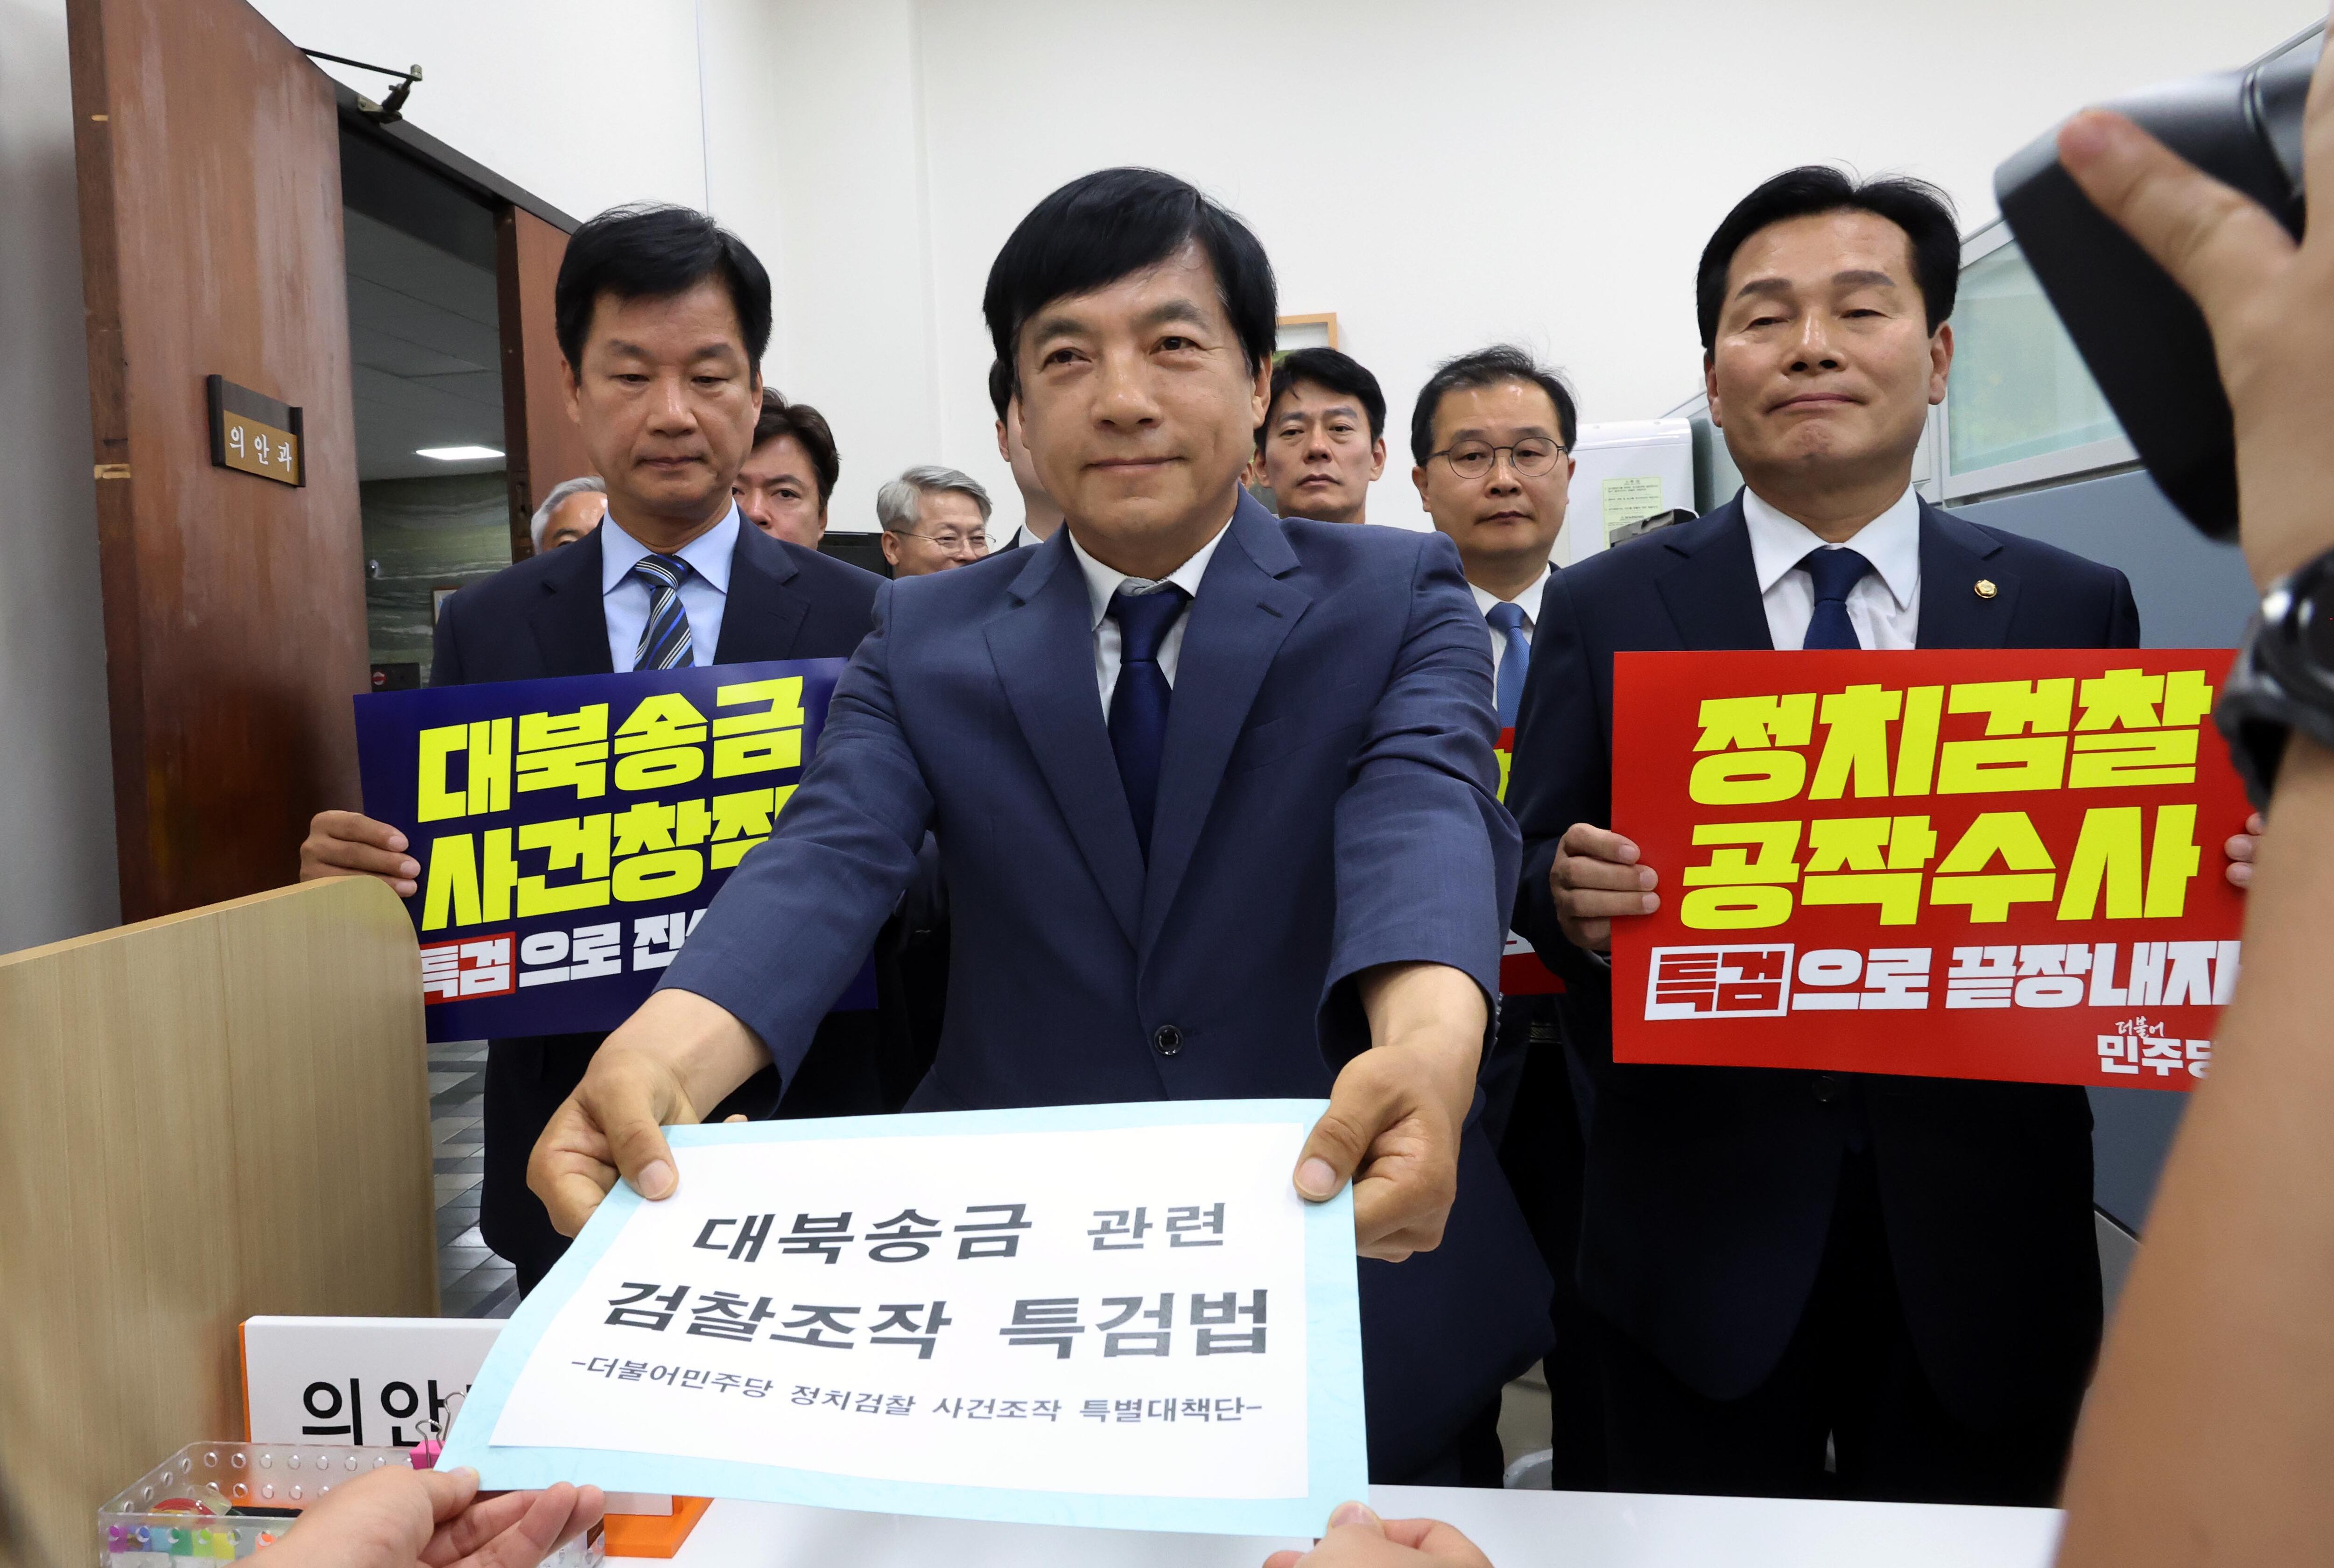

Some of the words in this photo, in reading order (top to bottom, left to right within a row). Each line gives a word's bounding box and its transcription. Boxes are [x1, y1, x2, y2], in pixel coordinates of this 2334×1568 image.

[418, 676, 805, 823] 대북송금
[1689, 668, 2214, 805] 정치검찰
[1680, 804, 2201, 929] 공작수사
[633, 908, 708, 971] 진
[1655, 947, 1932, 1013] 특검으로
[2115, 1015, 2165, 1039] 더불어
[692, 1203, 1032, 1265] 대북송금
[1087, 1202, 1225, 1251] 관련
[604, 1281, 953, 1360] 검찰조작
[999, 1289, 1268, 1359] 특검법
[302, 1378, 472, 1447] 의안
[571, 1357, 773, 1399] -더불어민주당
[791, 1385, 916, 1416] 정치검찰
[932, 1397, 1062, 1422] 사건조작
[1079, 1397, 1262, 1423] 특별대책단-
